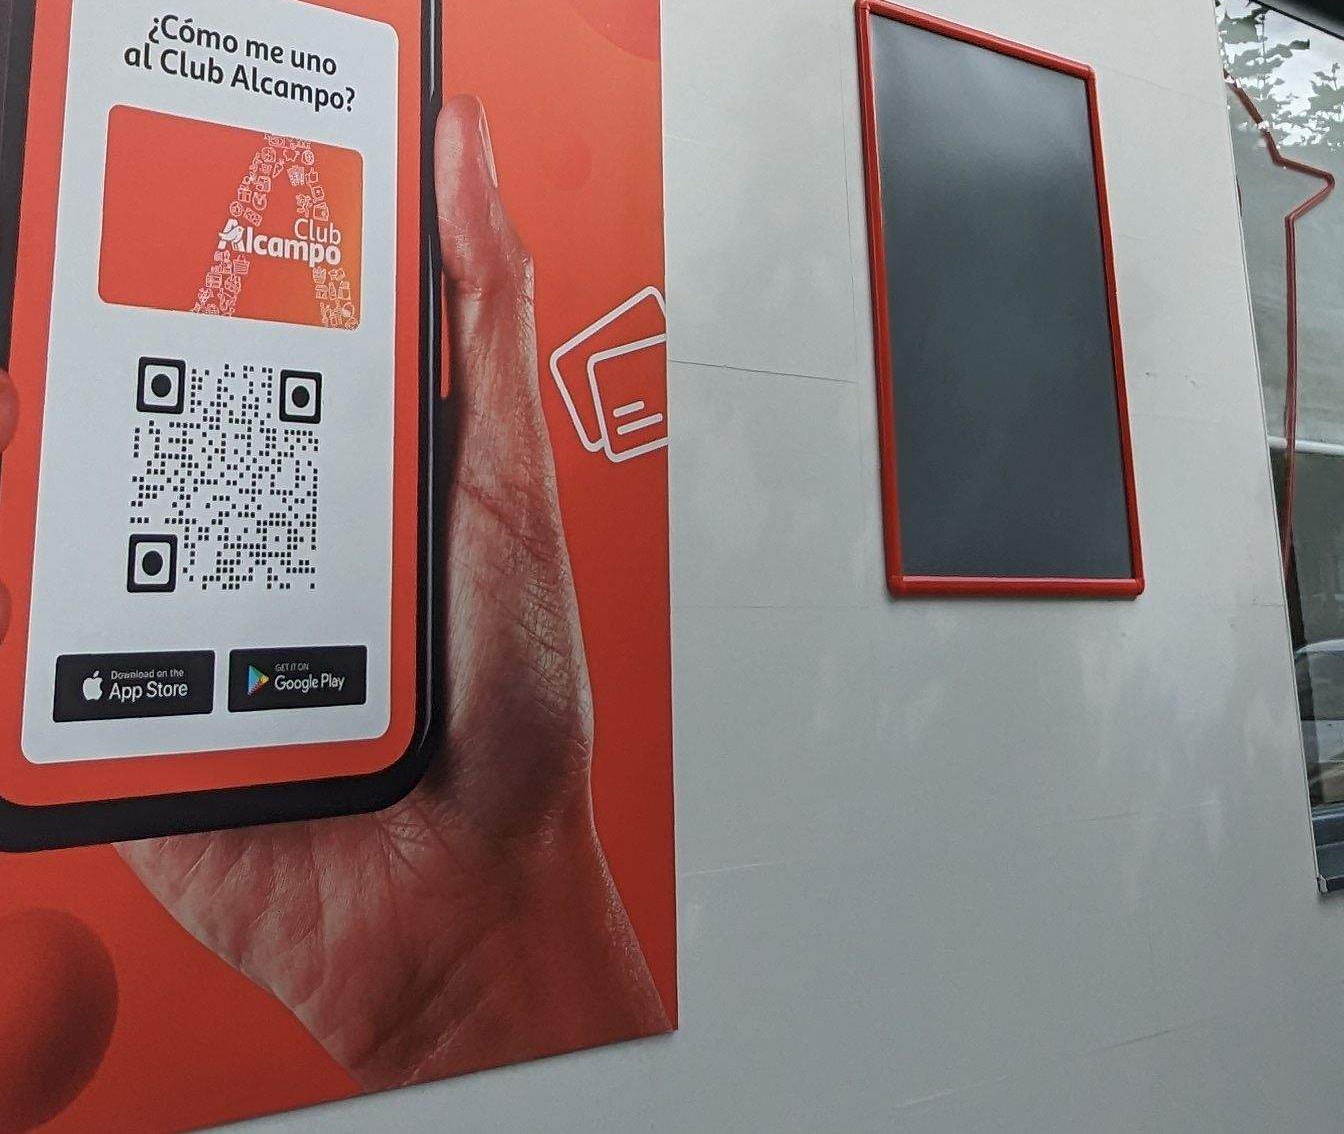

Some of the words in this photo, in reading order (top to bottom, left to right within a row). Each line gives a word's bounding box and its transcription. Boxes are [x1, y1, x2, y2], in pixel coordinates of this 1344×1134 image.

[148, 14, 238, 53] ¿Cómo
[246, 39, 284, 64] me
[291, 49, 337, 76] uno
[124, 42, 152, 70] al
[160, 48, 224, 85] Club
[230, 64, 355, 113] Alcampo?
[217, 218, 342, 268] Alcampo
[294, 218, 341, 245] Club
[111, 669, 155, 680] Download
[157, 670, 168, 678] on
[170, 669, 184, 677] the
[274, 673, 318, 693] Google
[321, 672, 346, 692] Play
[108, 682, 143, 703] App
[145, 680, 189, 698] Store
